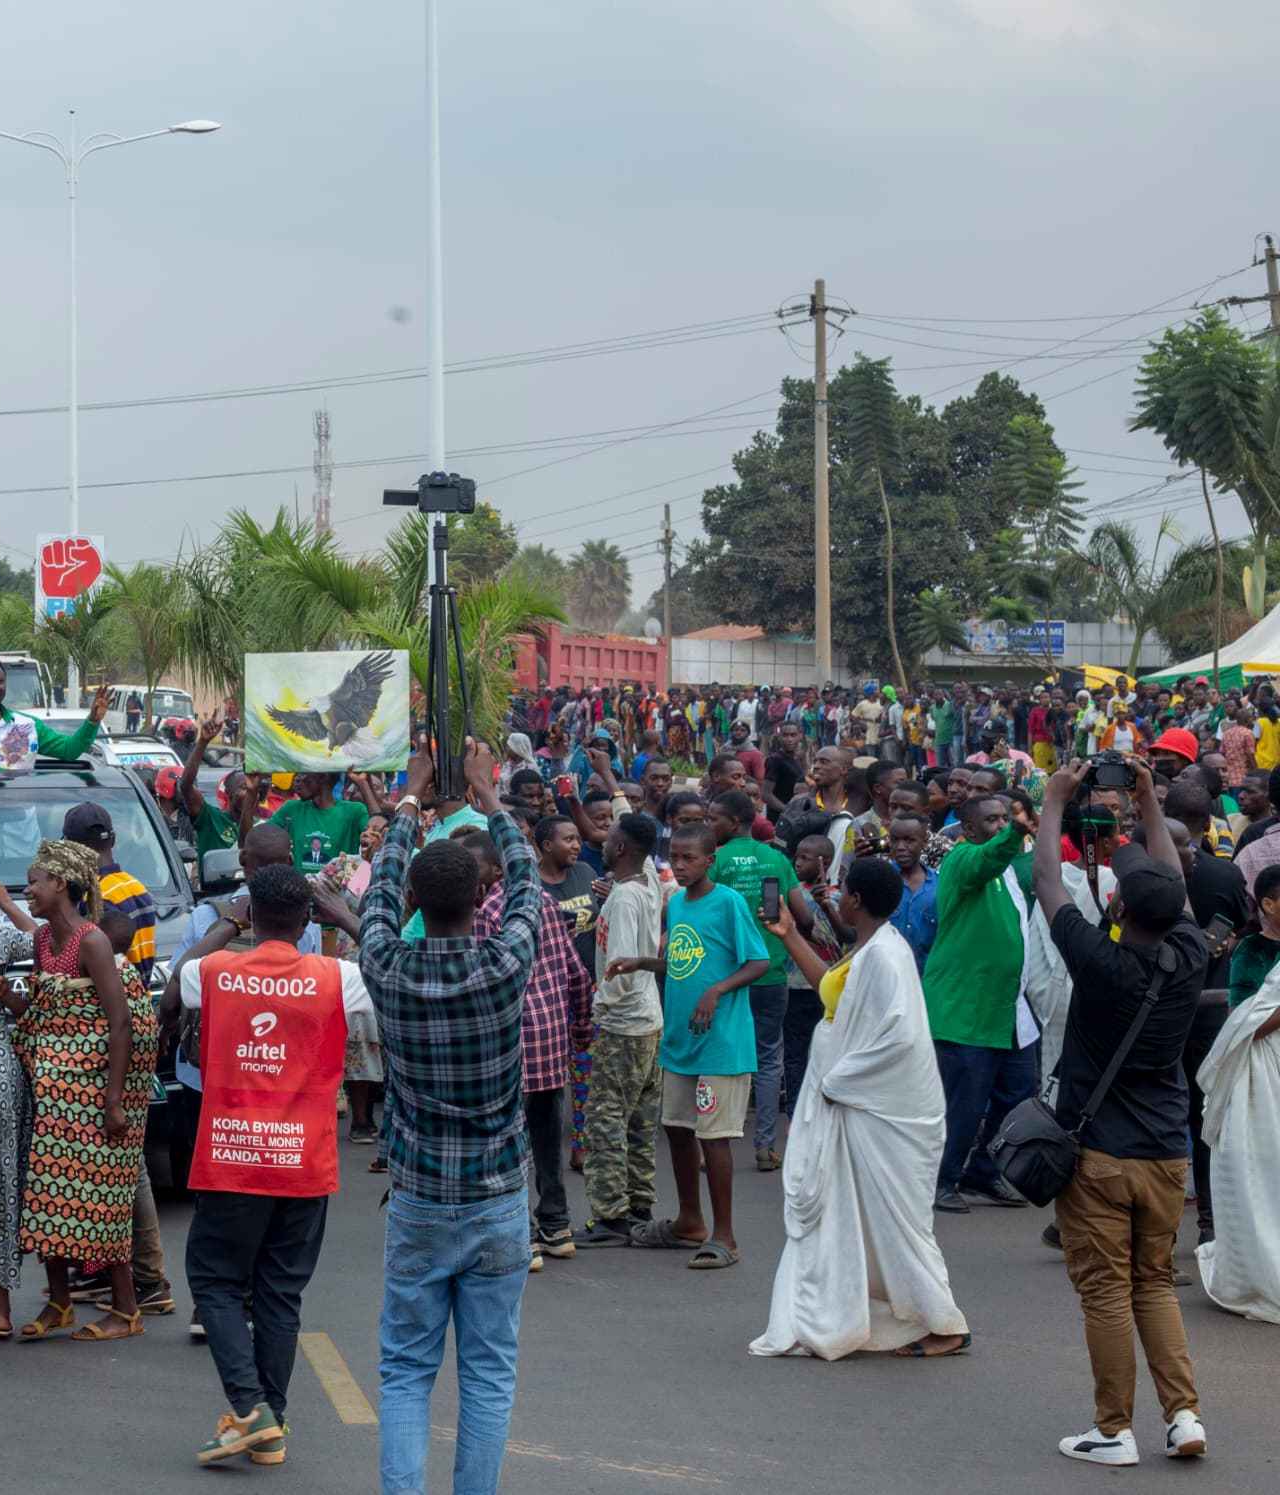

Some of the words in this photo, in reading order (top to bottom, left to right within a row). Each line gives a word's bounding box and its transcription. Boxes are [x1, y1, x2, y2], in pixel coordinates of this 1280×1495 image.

[218, 972, 317, 996] GAS0002
[236, 1041, 286, 1060] airtel
[240, 1062, 283, 1076] money
[212, 1118, 249, 1132] KORA
[253, 1121, 304, 1134] BYINSHI
[212, 1132, 227, 1143] NA
[229, 1134, 265, 1146] AIRTEL
[268, 1136, 305, 1147] MONEY
[212, 1147, 261, 1162] KANDA
